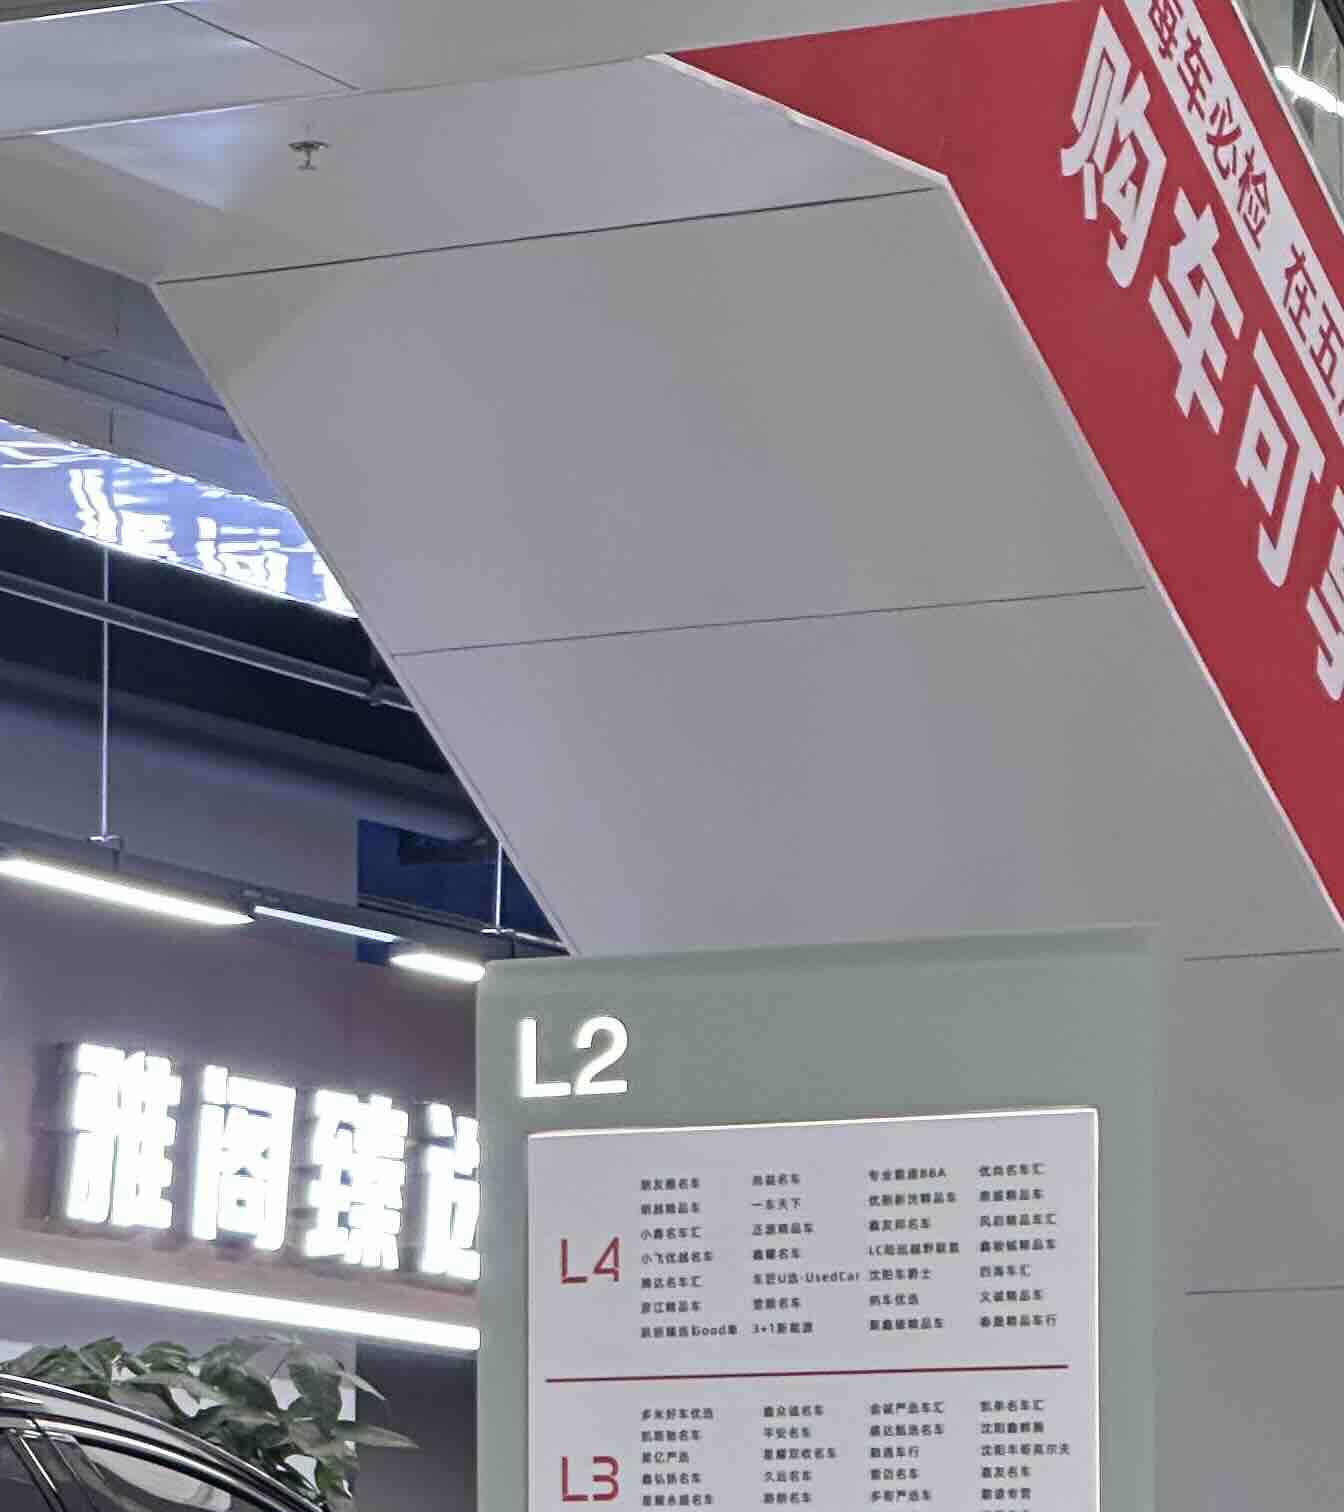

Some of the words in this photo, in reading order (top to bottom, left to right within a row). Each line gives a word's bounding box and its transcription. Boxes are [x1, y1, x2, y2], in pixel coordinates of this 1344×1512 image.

[1282, 242, 1344, 415] 在五
[519, 1016, 629, 1098] L2
[560, 1237, 620, 1284] L4
[561, 1455, 620, 1502] L3
